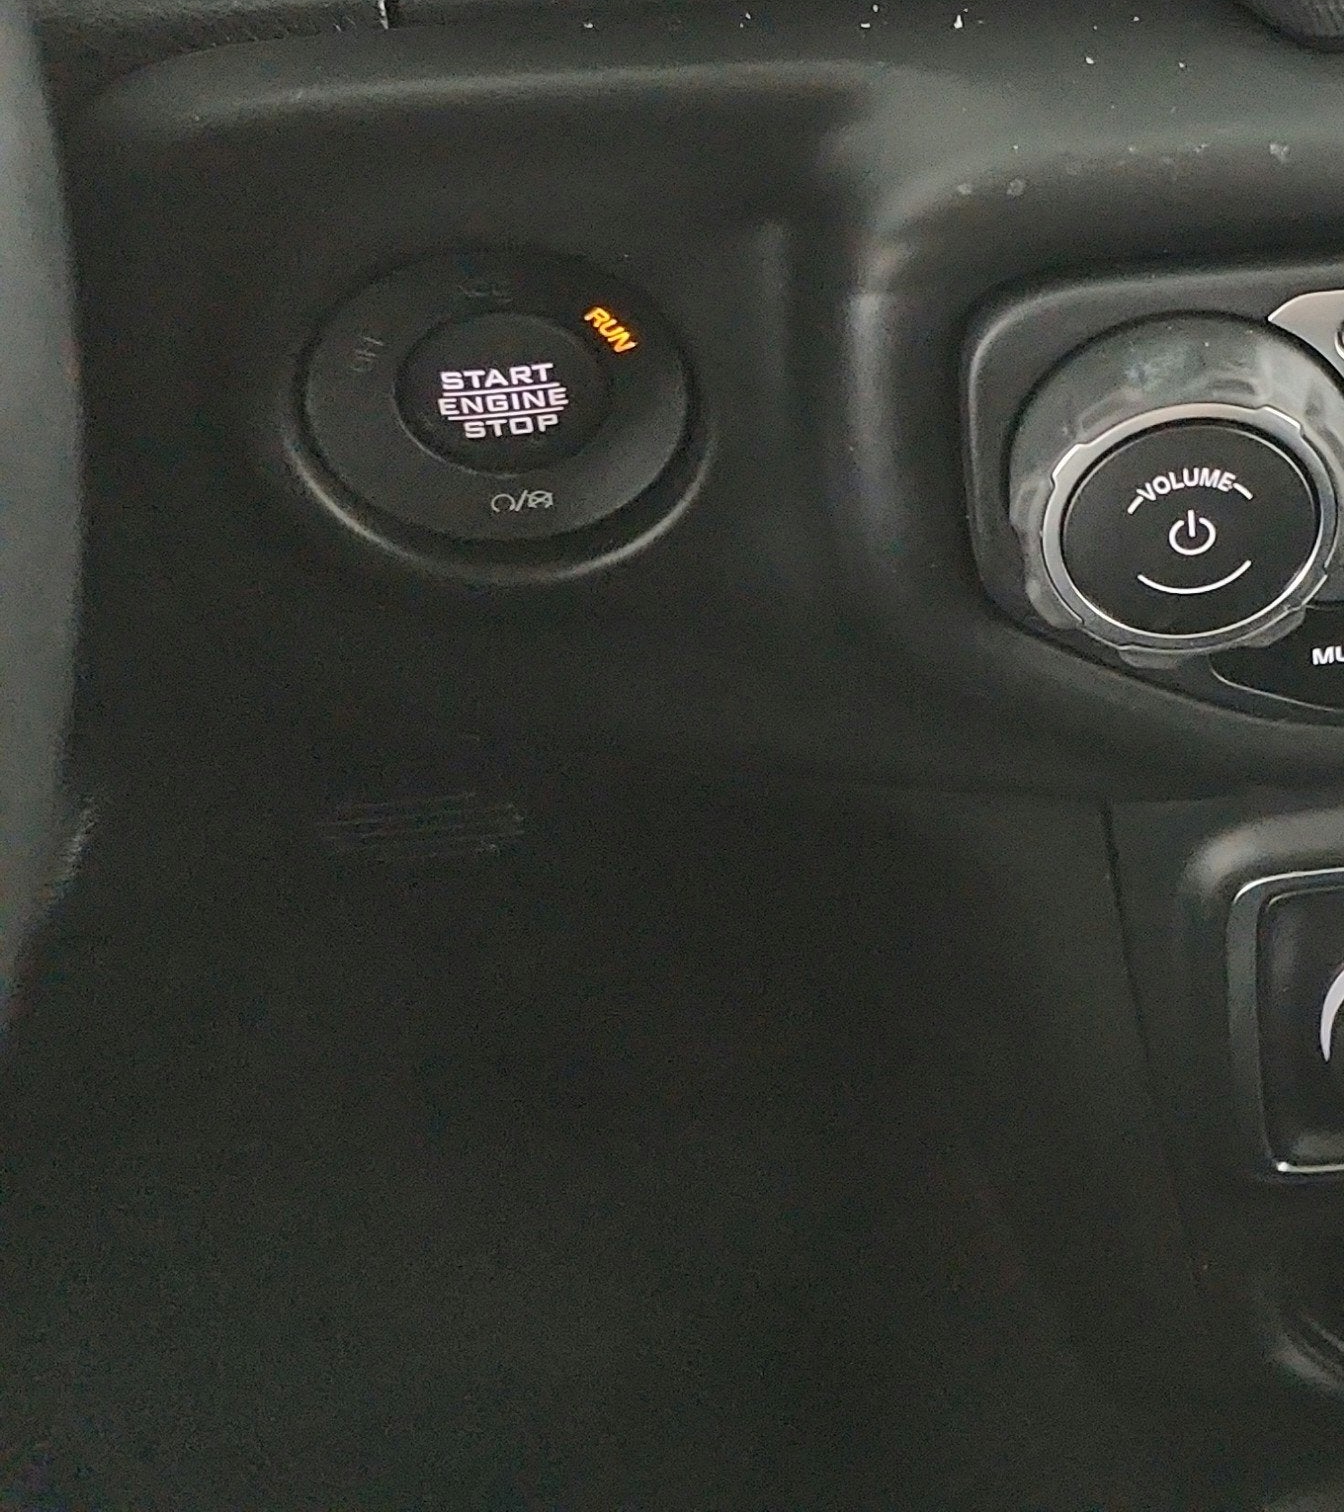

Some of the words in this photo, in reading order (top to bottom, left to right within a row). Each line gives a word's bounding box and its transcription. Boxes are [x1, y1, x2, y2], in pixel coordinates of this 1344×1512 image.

[584, 307, 637, 353] RUN
[440, 362, 554, 391] START
[438, 386, 569, 416] ENGINE
[463, 413, 559, 439] STOP
[1138, 467, 1236, 503] VOLUME
